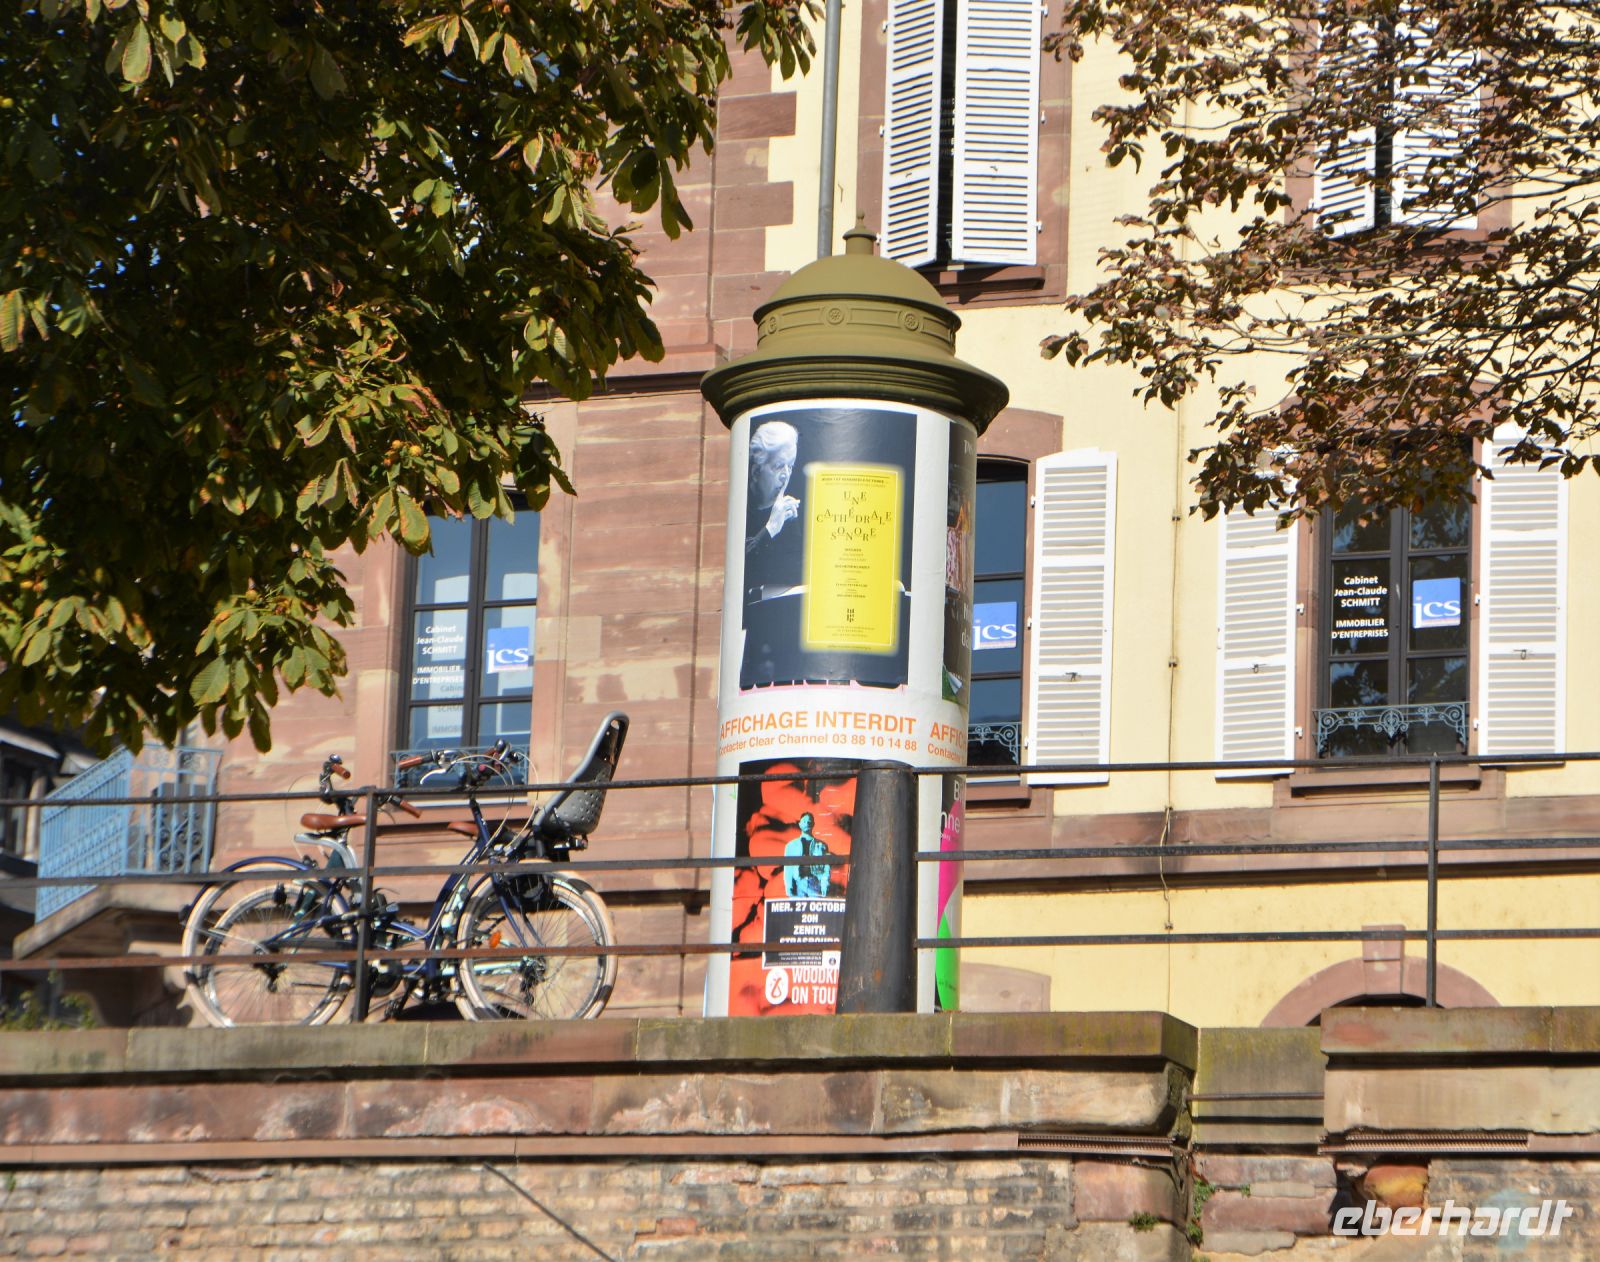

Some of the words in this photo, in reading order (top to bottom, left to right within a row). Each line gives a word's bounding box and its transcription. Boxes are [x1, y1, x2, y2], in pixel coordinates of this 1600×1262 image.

[844, 491, 867, 505] UNE
[830, 526, 877, 542] SONORE
[1343, 576, 1379, 586] Cabinet
[1334, 586, 1388, 597] Jean-Claude
[1340, 597, 1381, 608] SCHMITT
[1335, 618, 1385, 628] IMMOBILIER
[425, 625, 457, 634] Cabinet
[1331, 629, 1389, 639] D'ENTREPRISES
[416, 635, 464, 645] Jean-Claude
[422, 646, 458, 655] SCHMITT
[416, 665, 461, 674] IMMOBILIER
[412, 676, 464, 684] D'ENTREPRISES
[720, 711, 808, 740] AFFICHAGE
[815, 710, 917, 735] INTERDIT
[748, 735, 775, 748] Clear
[778, 732, 829, 745] Channel
[832, 733, 847, 744] 03
[851, 735, 866, 745] 88
[870, 735, 884, 747] 10
[888, 737, 901, 749] 14
[904, 740, 917, 751] 88
[771, 902, 793, 912] MER.
[795, 902, 807, 912] 27
[801, 914, 819, 924] 20H
[793, 925, 826, 935] ZENITH
[791, 985, 809, 1004] ON
